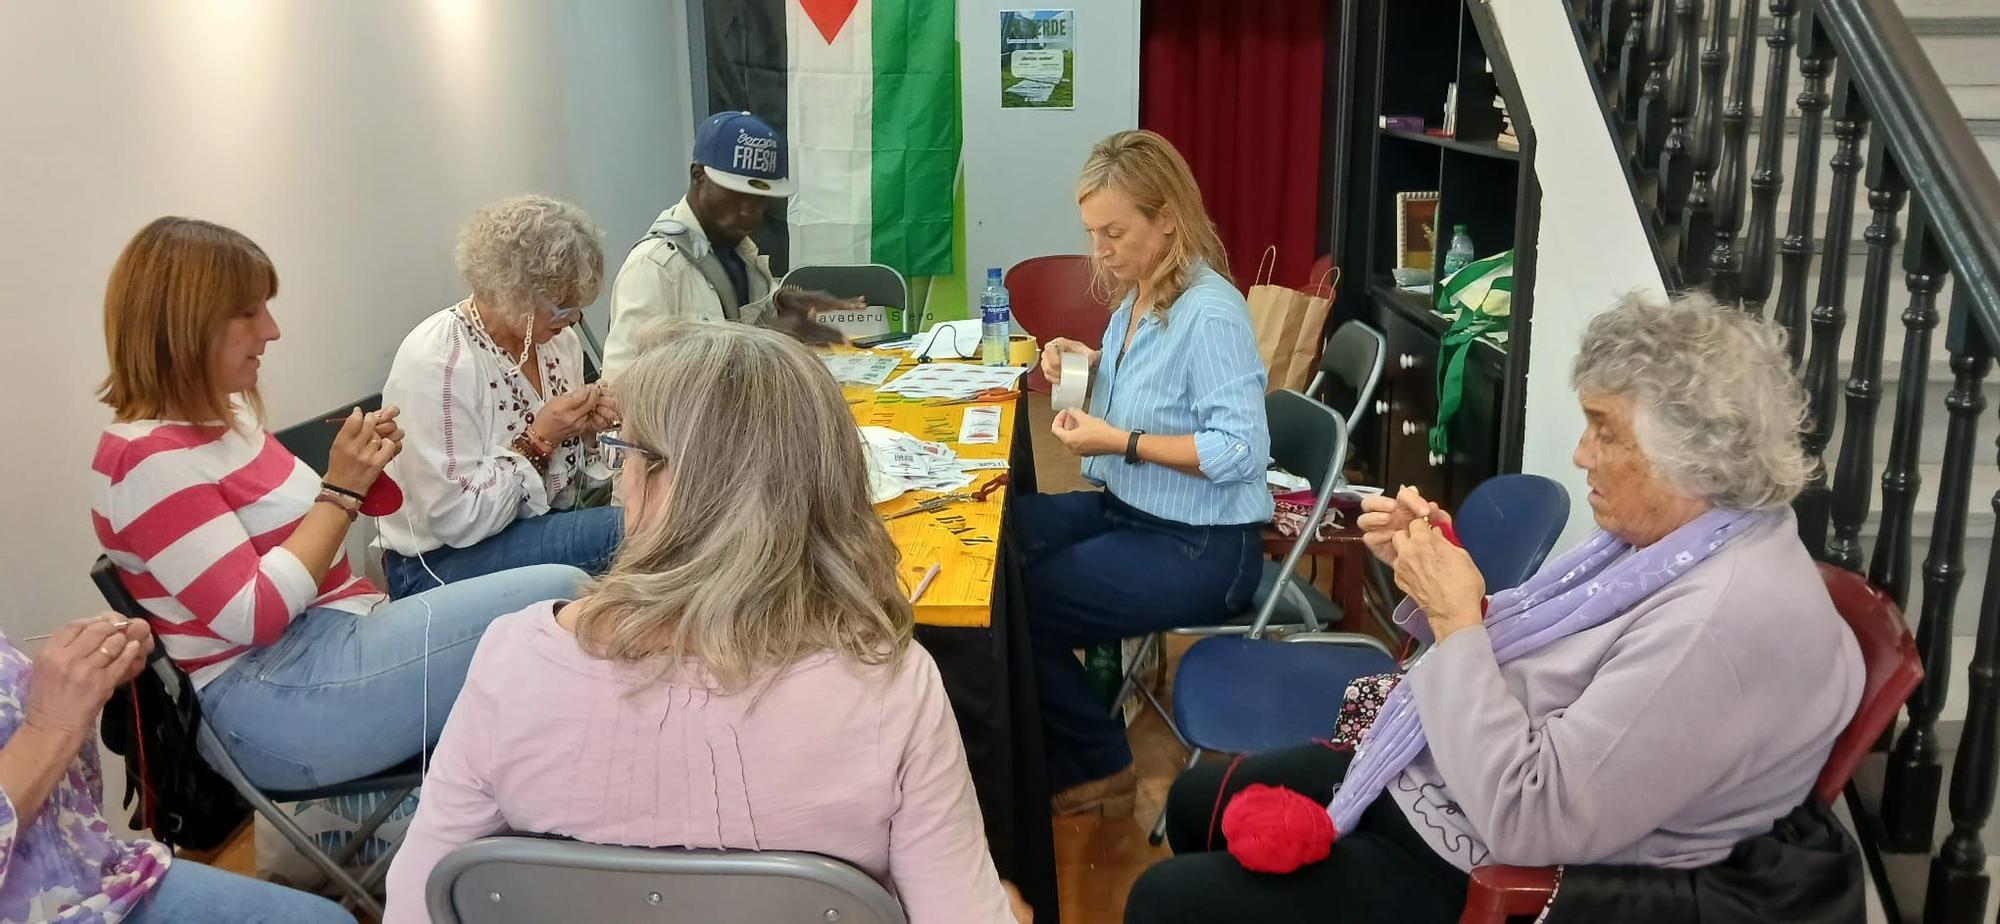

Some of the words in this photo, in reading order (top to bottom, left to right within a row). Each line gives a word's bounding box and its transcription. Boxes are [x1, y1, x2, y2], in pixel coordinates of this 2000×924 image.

[733, 145, 777, 173] FRESH
[819, 311, 883, 323] avaderu
[891, 311, 934, 322] Sero
